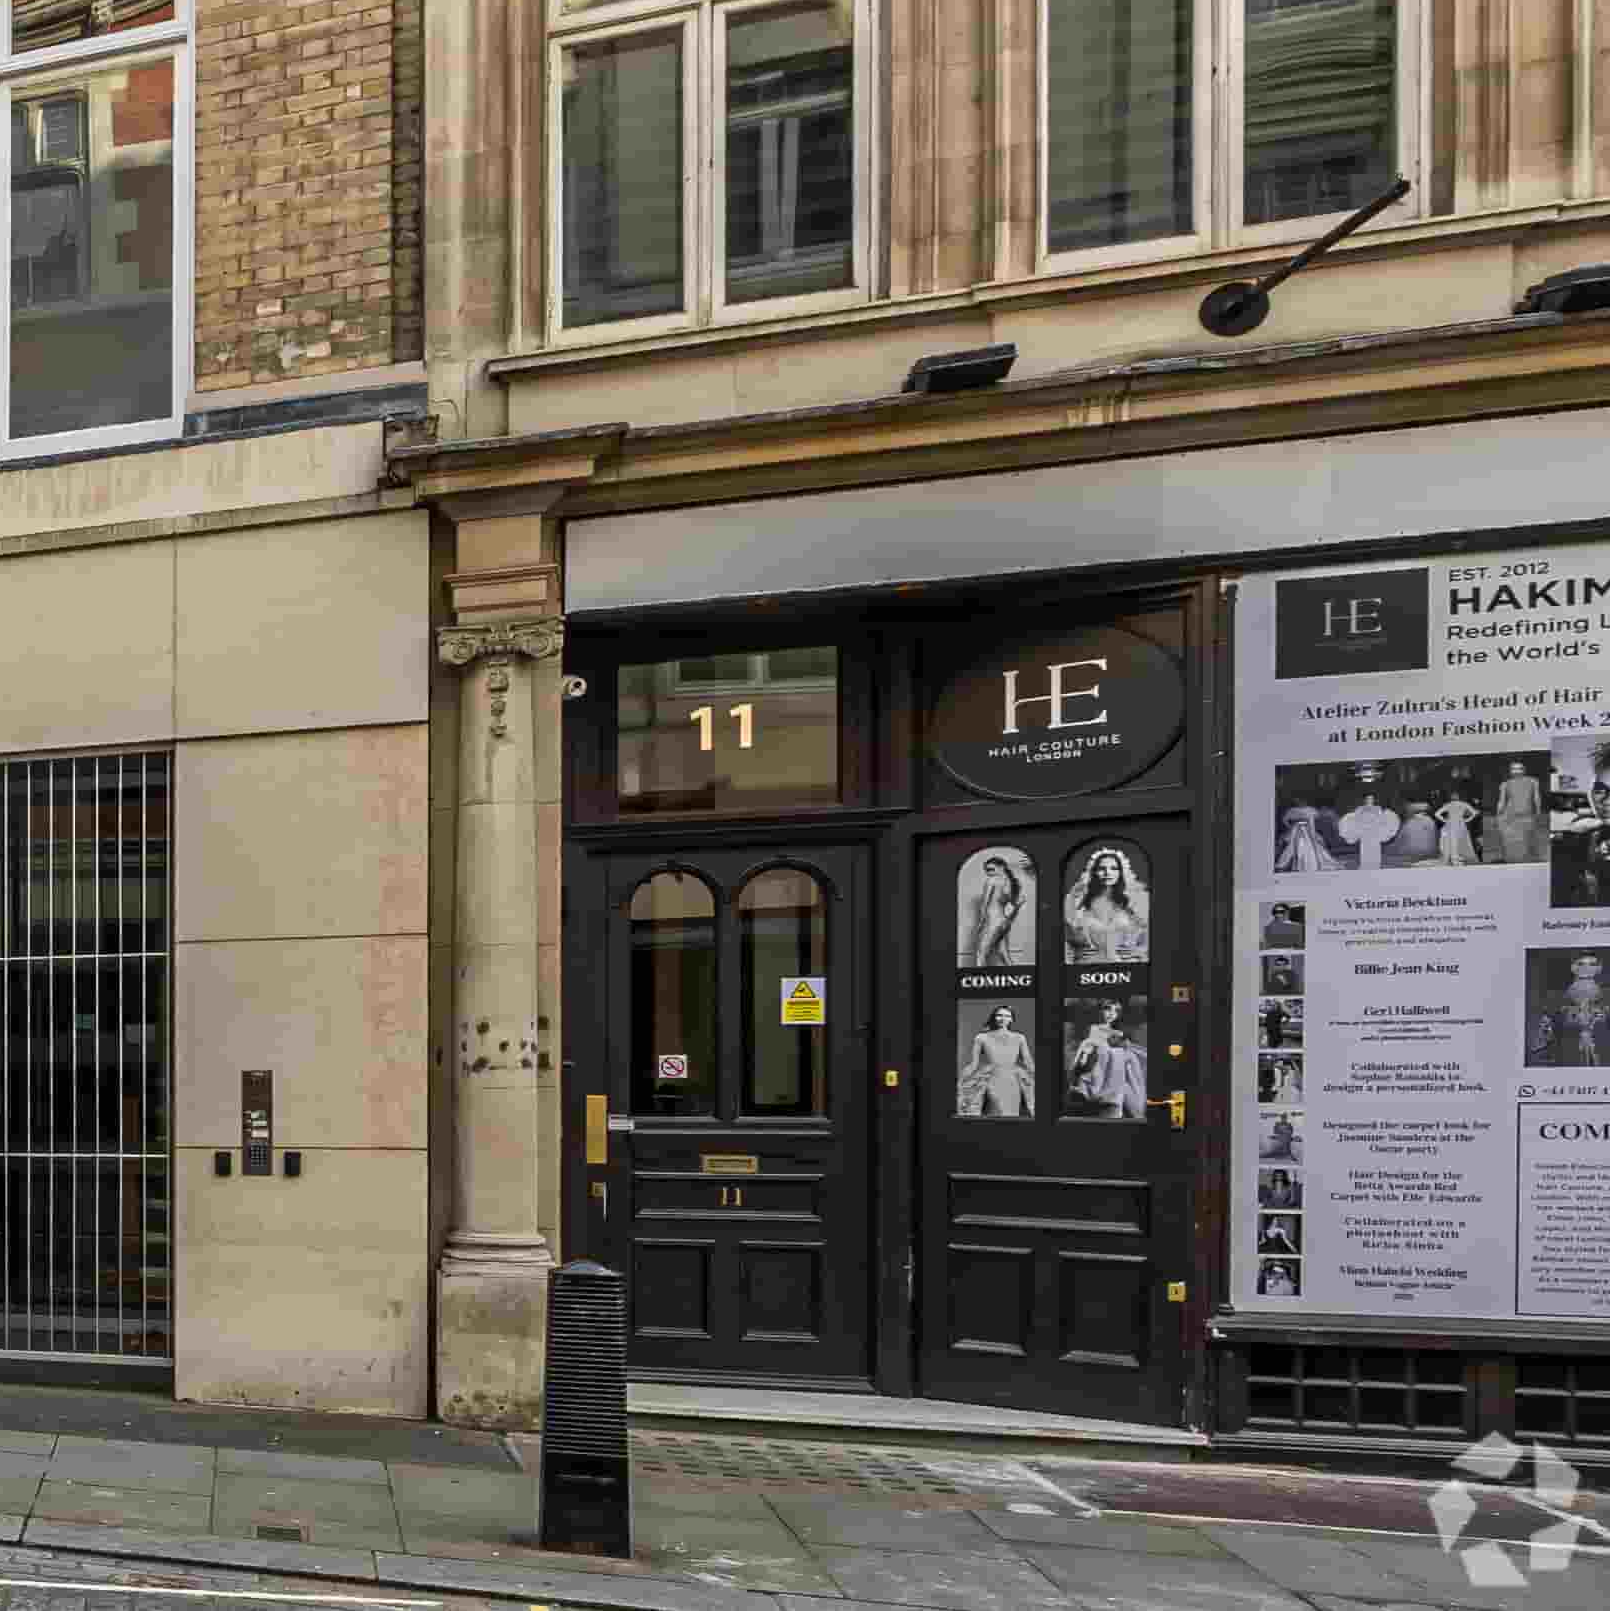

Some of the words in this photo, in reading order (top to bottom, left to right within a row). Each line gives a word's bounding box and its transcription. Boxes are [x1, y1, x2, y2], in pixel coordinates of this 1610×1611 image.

[1449, 567, 1491, 582] EST.
[1499, 562, 1549, 578] 2012
[1449, 577, 1610, 615] HAKIM
[1447, 618, 1590, 640] Redefining
[1447, 648, 1488, 666] the
[1497, 640, 1601, 662] World's
[1002, 658, 1107, 735] HE
[1300, 703, 1371, 720] Atelier
[1463, 691, 1517, 711] Head
[1525, 689, 1547, 704] of
[1554, 686, 1603, 704] Hair
[690, 702, 753, 751] 11
[1328, 730, 1347, 743] at
[1355, 722, 1435, 742] London
[1442, 719, 1525, 737] Fashion
[1532, 712, 1593, 730] Week
[988, 744, 1028, 758] HAIR
[1039, 733, 1123, 752] COUTURE
[1027, 749, 1082, 764] LONDON
[962, 974, 1033, 988] COMING
[1080, 971, 1132, 984] SOON
